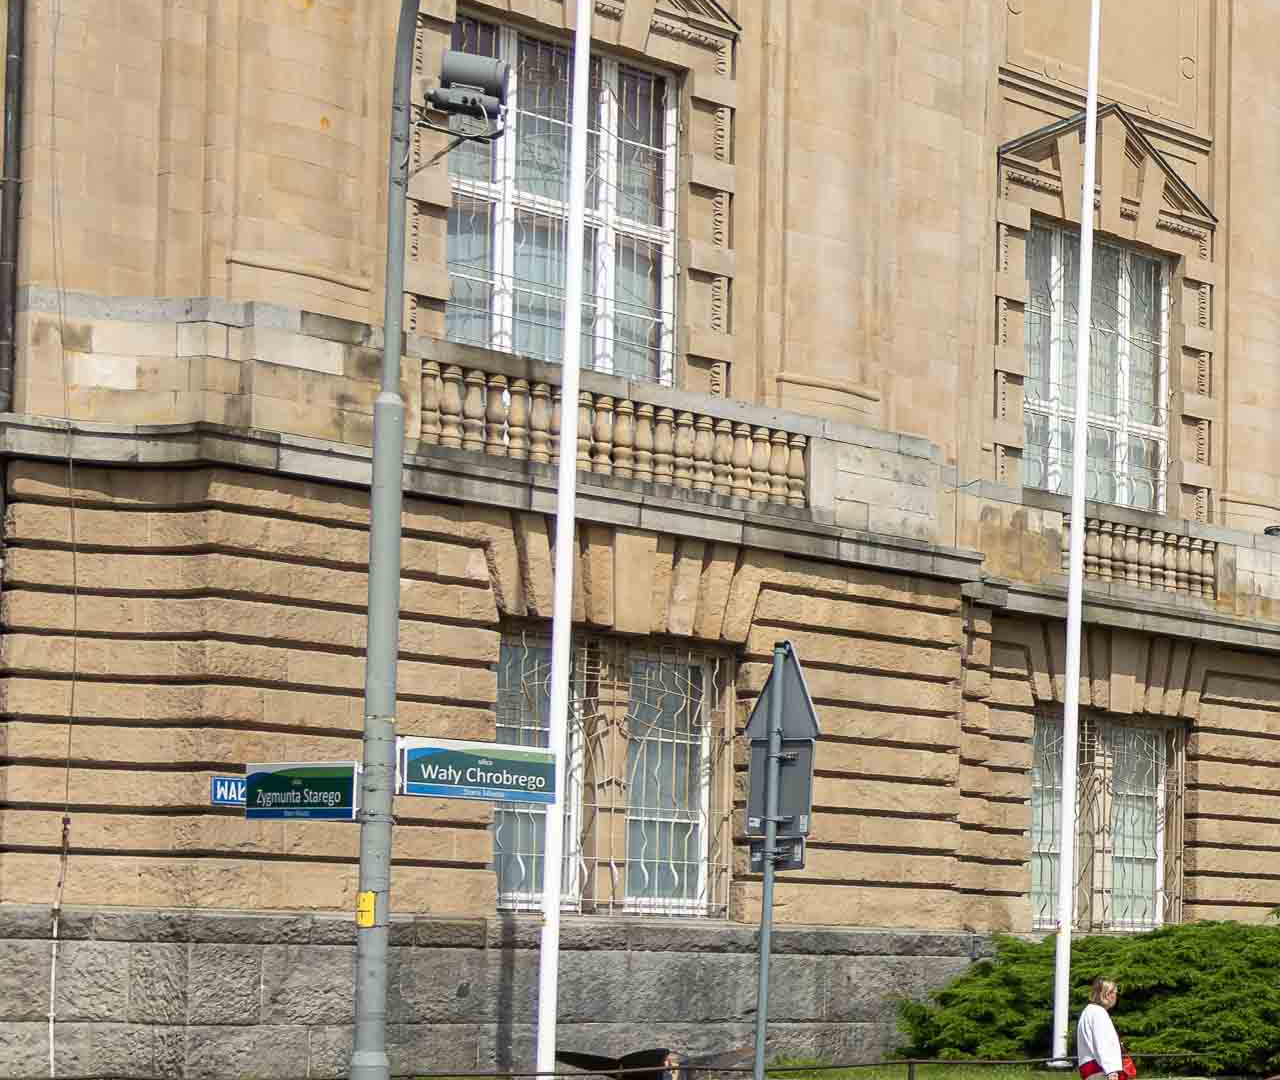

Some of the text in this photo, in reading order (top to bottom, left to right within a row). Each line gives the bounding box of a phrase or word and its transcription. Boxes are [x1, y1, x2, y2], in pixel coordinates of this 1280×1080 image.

[420, 764, 546, 790] Wały Chrobrego
[256, 788, 341, 807] Zygmunta Starego
